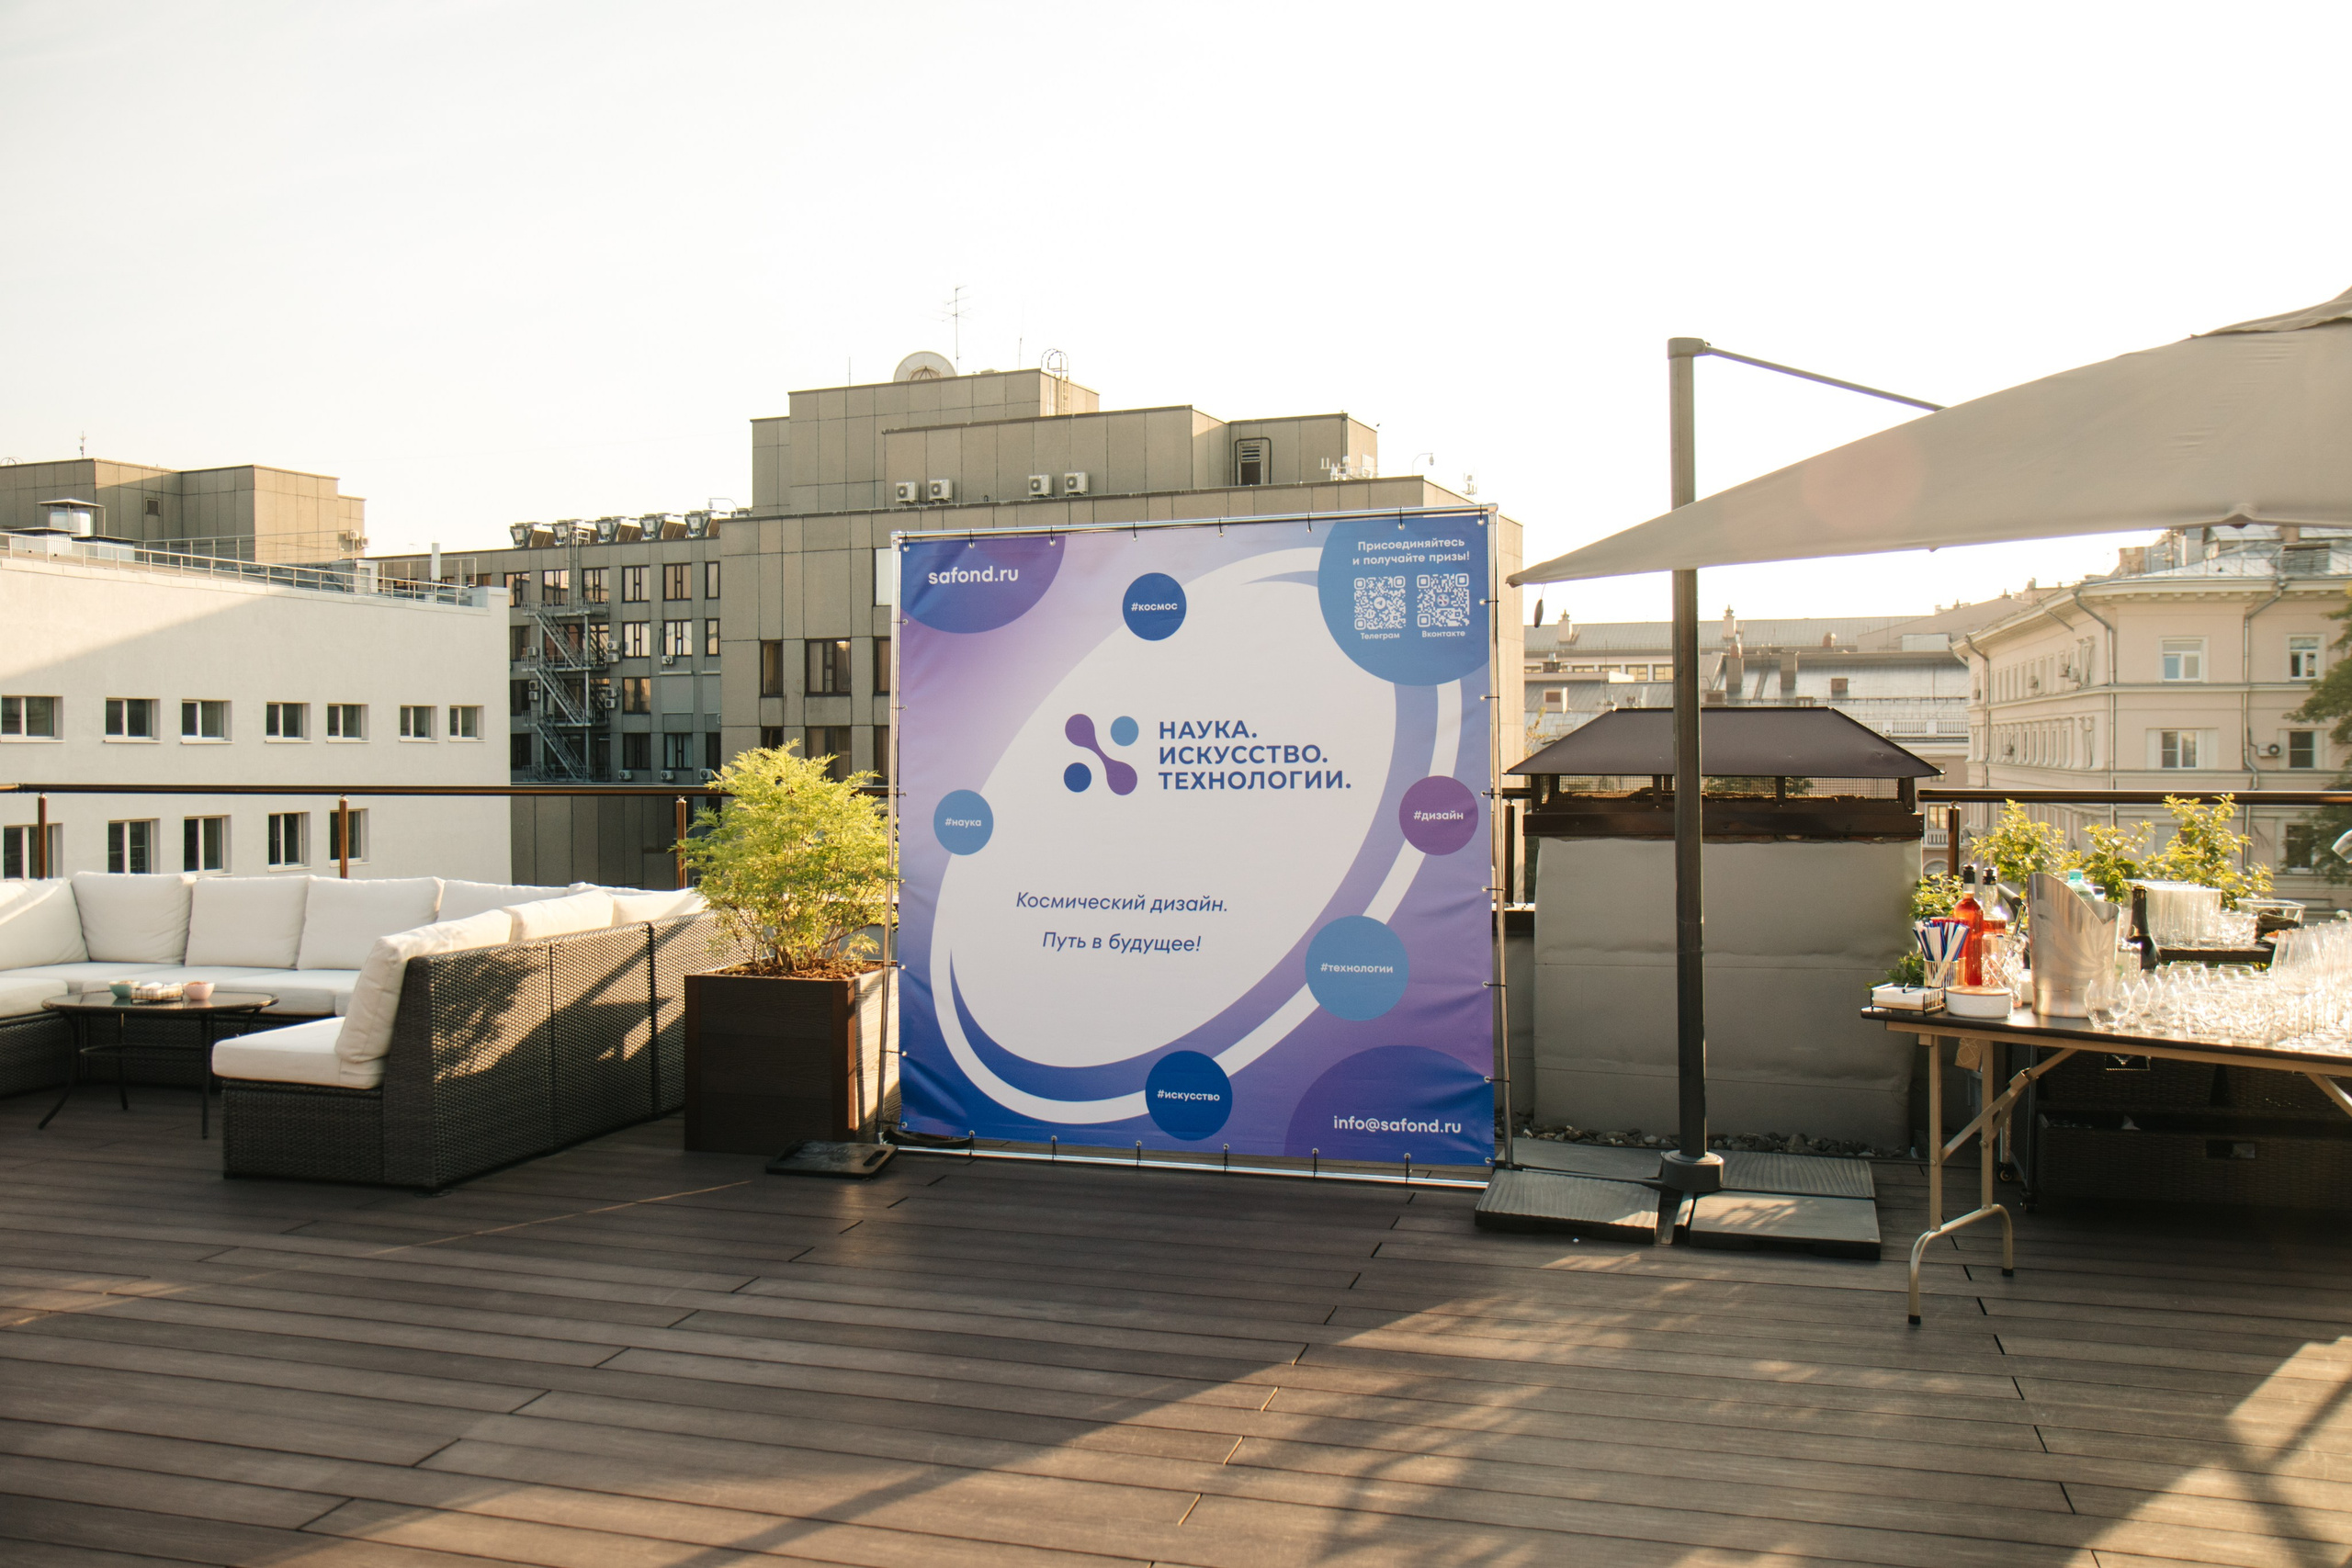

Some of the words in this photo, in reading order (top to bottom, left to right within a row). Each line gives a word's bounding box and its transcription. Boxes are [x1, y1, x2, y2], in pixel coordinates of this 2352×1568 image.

[1357, 537, 1465, 553] Присоединяйтесь
[1353, 558, 1360, 566] и
[1363, 552, 1426, 567] получайте
[1429, 550, 1470, 564] призы!
[928, 565, 1019, 585] safond.ru
[1130, 602, 1178, 612] #космос
[1360, 632, 1400, 641] Телеграм
[1421, 630, 1466, 638] Вконтакте
[1159, 719, 1258, 739] НАУКА.
[1159, 744, 1329, 765] ИСКУССТВО.
[1158, 770, 1351, 790] ТЕХНОЛОГИИ.
[944, 817, 982, 829] #наука
[1413, 809, 1464, 822] #дизайн
[1016, 891, 1146, 910] Космический
[1149, 895, 1227, 914] дизайн.
[1043, 931, 1086, 952] Путь
[1091, 937, 1102, 949] в
[1108, 932, 1202, 955] будущее!
[1320, 962, 1394, 974] #технологии
[1157, 1089, 1221, 1102] #искусство
[1333, 1115, 1462, 1134] info@safond.ru
